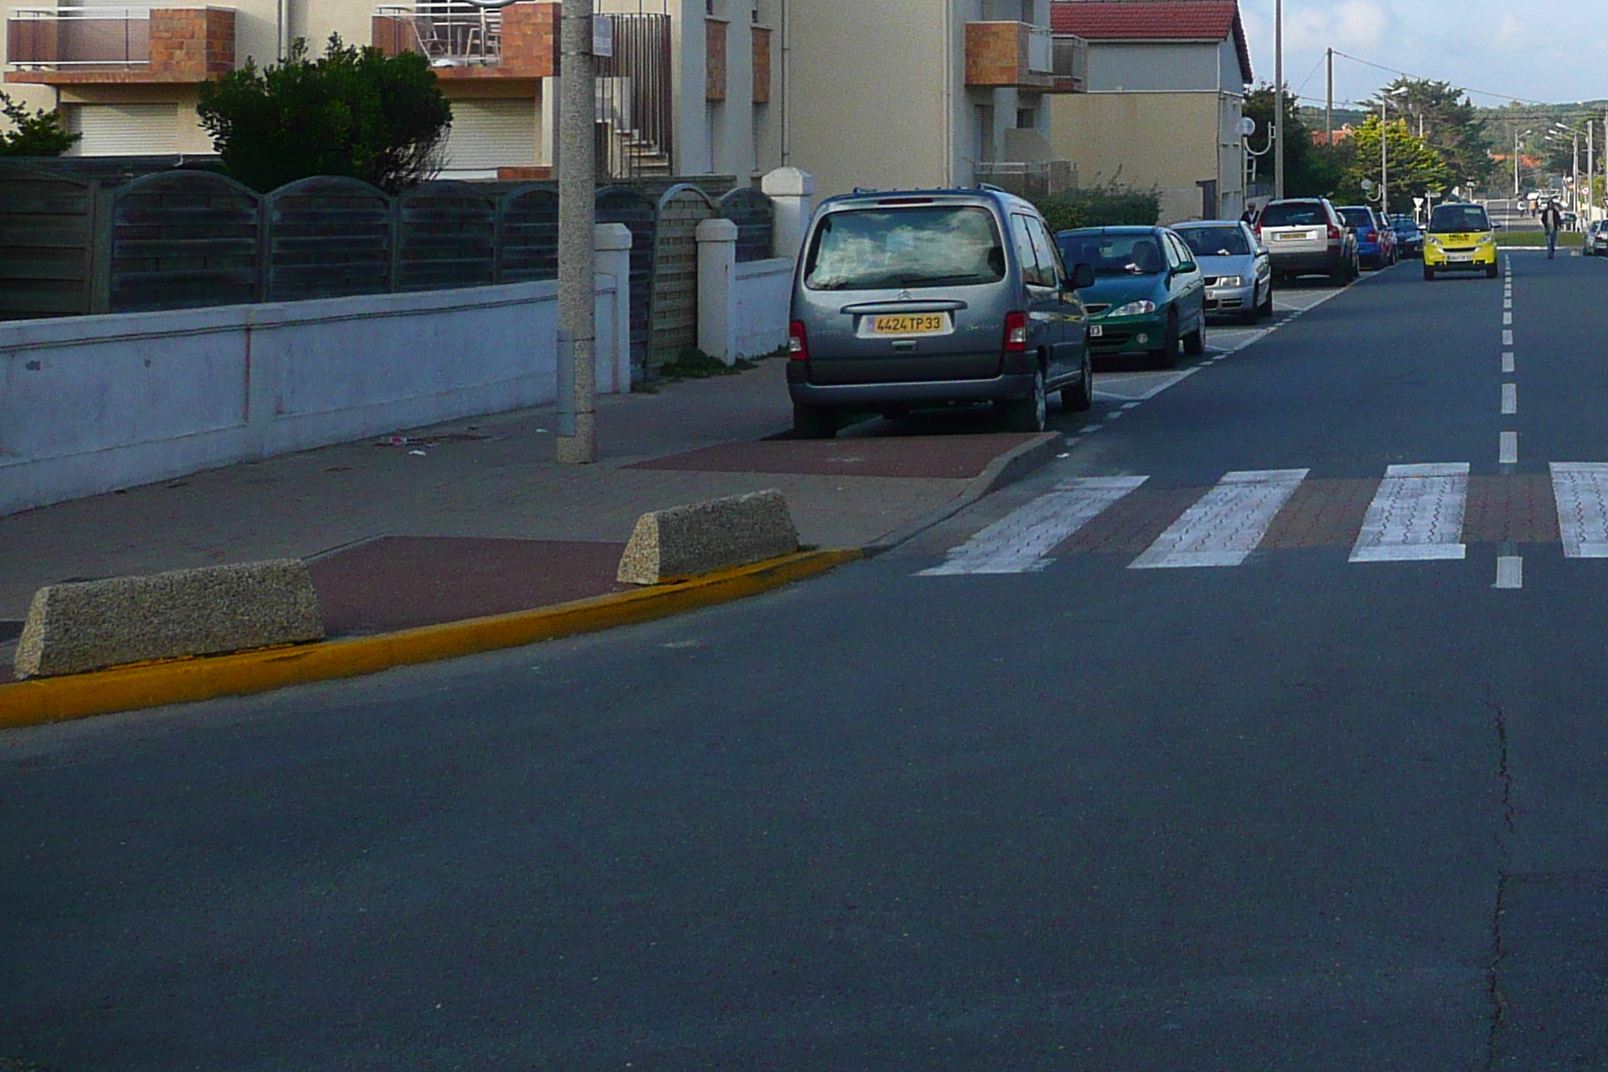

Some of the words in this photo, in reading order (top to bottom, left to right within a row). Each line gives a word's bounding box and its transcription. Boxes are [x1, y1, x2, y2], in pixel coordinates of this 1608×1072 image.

[877, 318, 907, 331] 4424
[909, 317, 924, 330] TP
[925, 317, 940, 330] 33
